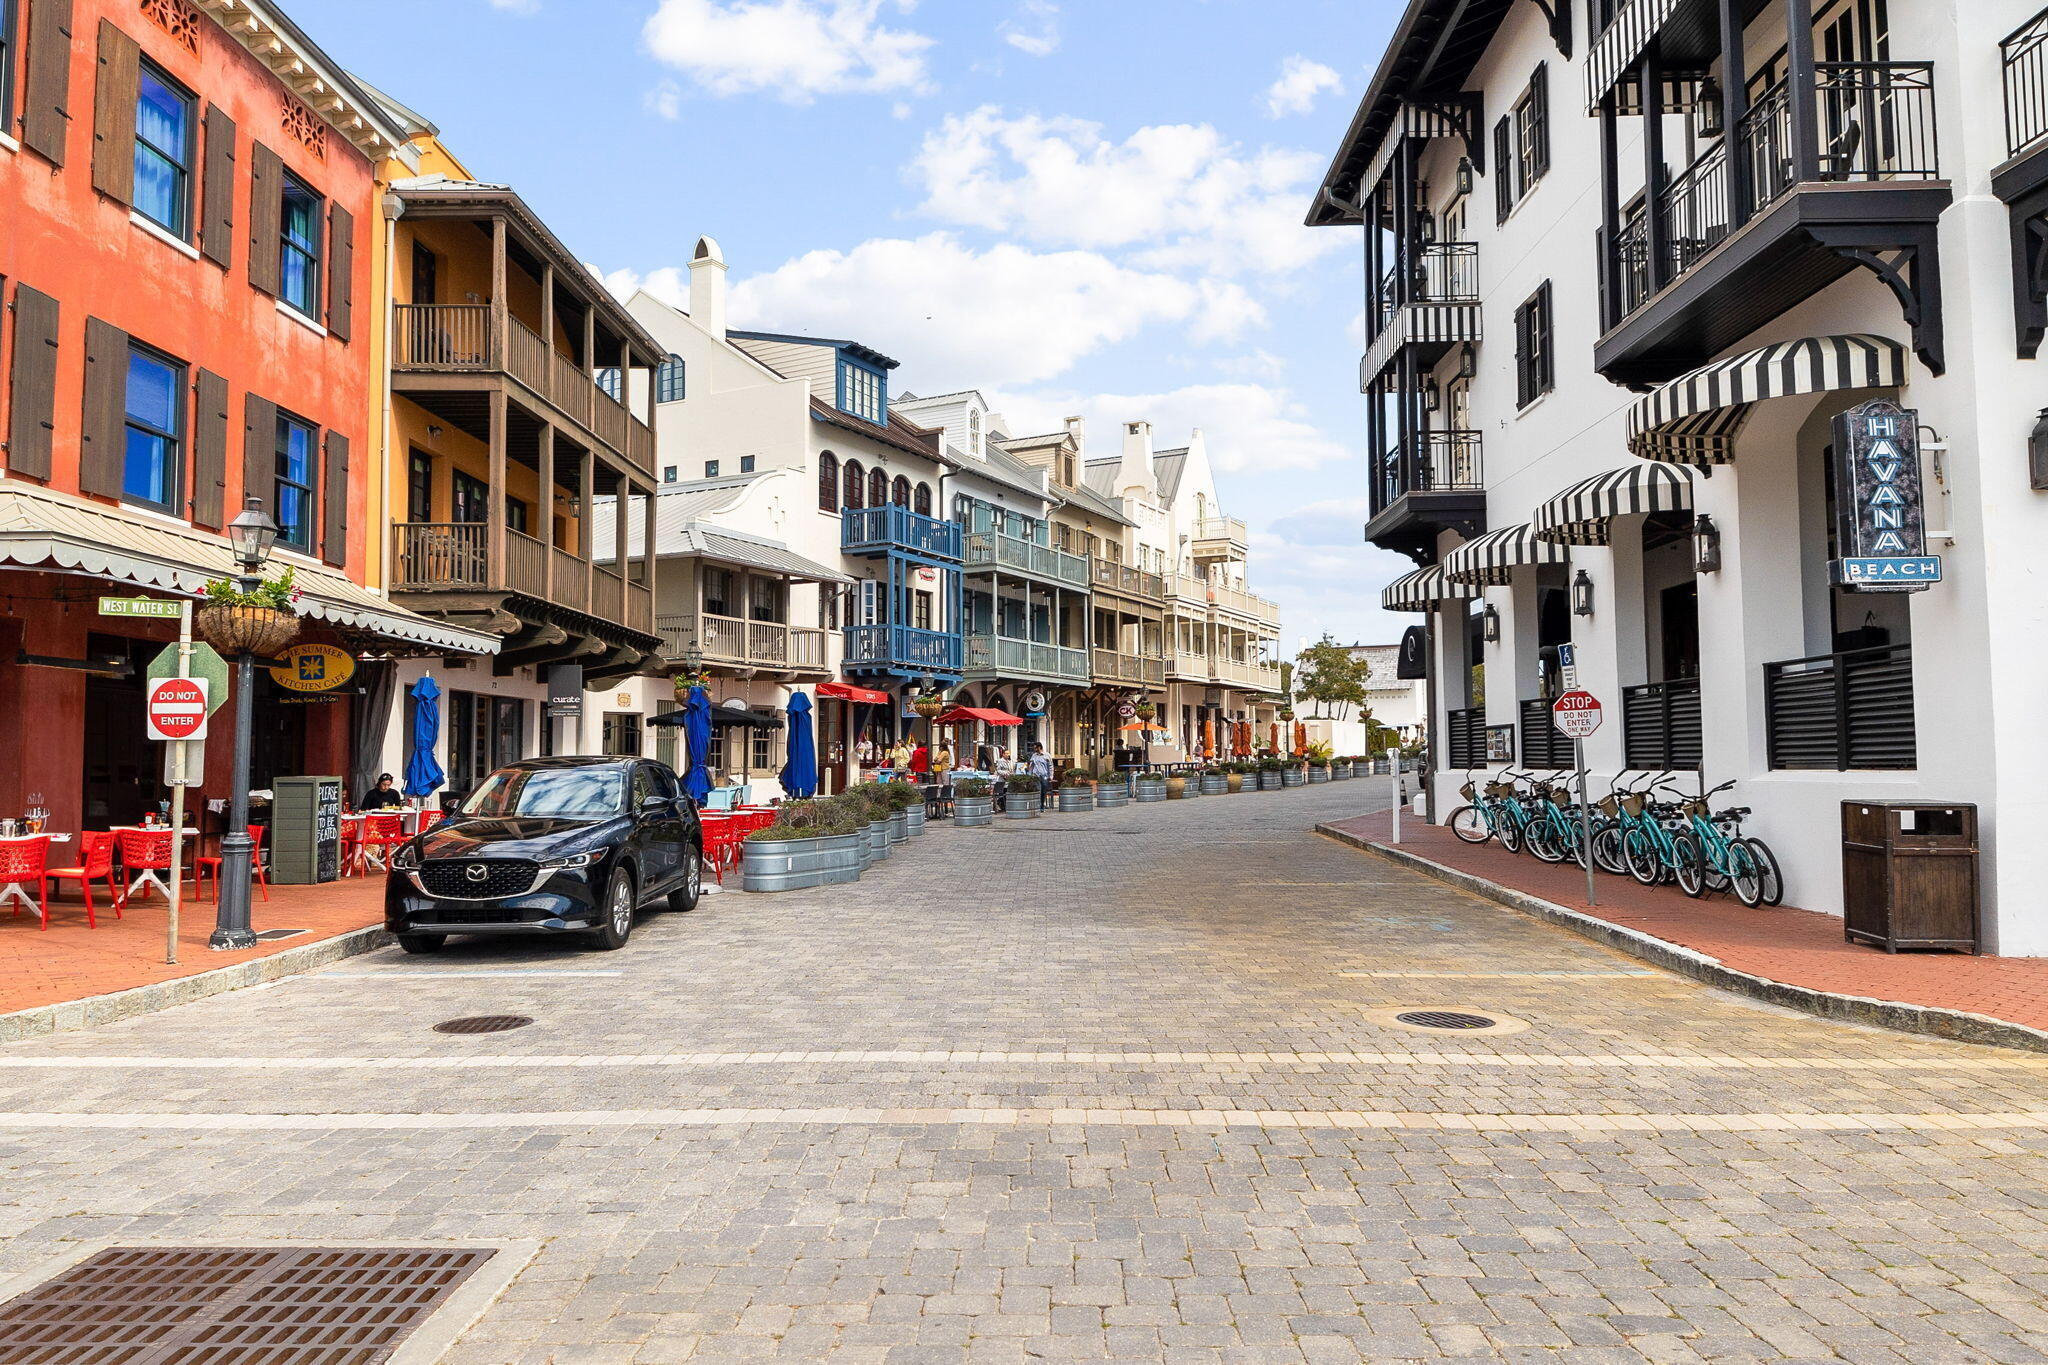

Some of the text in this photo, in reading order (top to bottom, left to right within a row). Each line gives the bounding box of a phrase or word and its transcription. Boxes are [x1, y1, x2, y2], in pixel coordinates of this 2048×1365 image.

[1867, 417, 1906, 551] HAVANA
[1849, 562, 1936, 576] BEACH
[103, 600, 128, 612] WEST
[132, 601, 164, 614] WATER
[301, 645, 343, 659] SUMMER
[278, 674, 321, 690] KITCHEN
[159, 691, 197, 700] DO NOT
[1563, 696, 1593, 709] STOP
[161, 716, 194, 725] ENTER
[1566, 719, 1591, 727] ENTER
[319, 786, 338, 800] PLEASE
[318, 816, 335, 828] TO BE
[317, 827, 337, 843] SEATED
